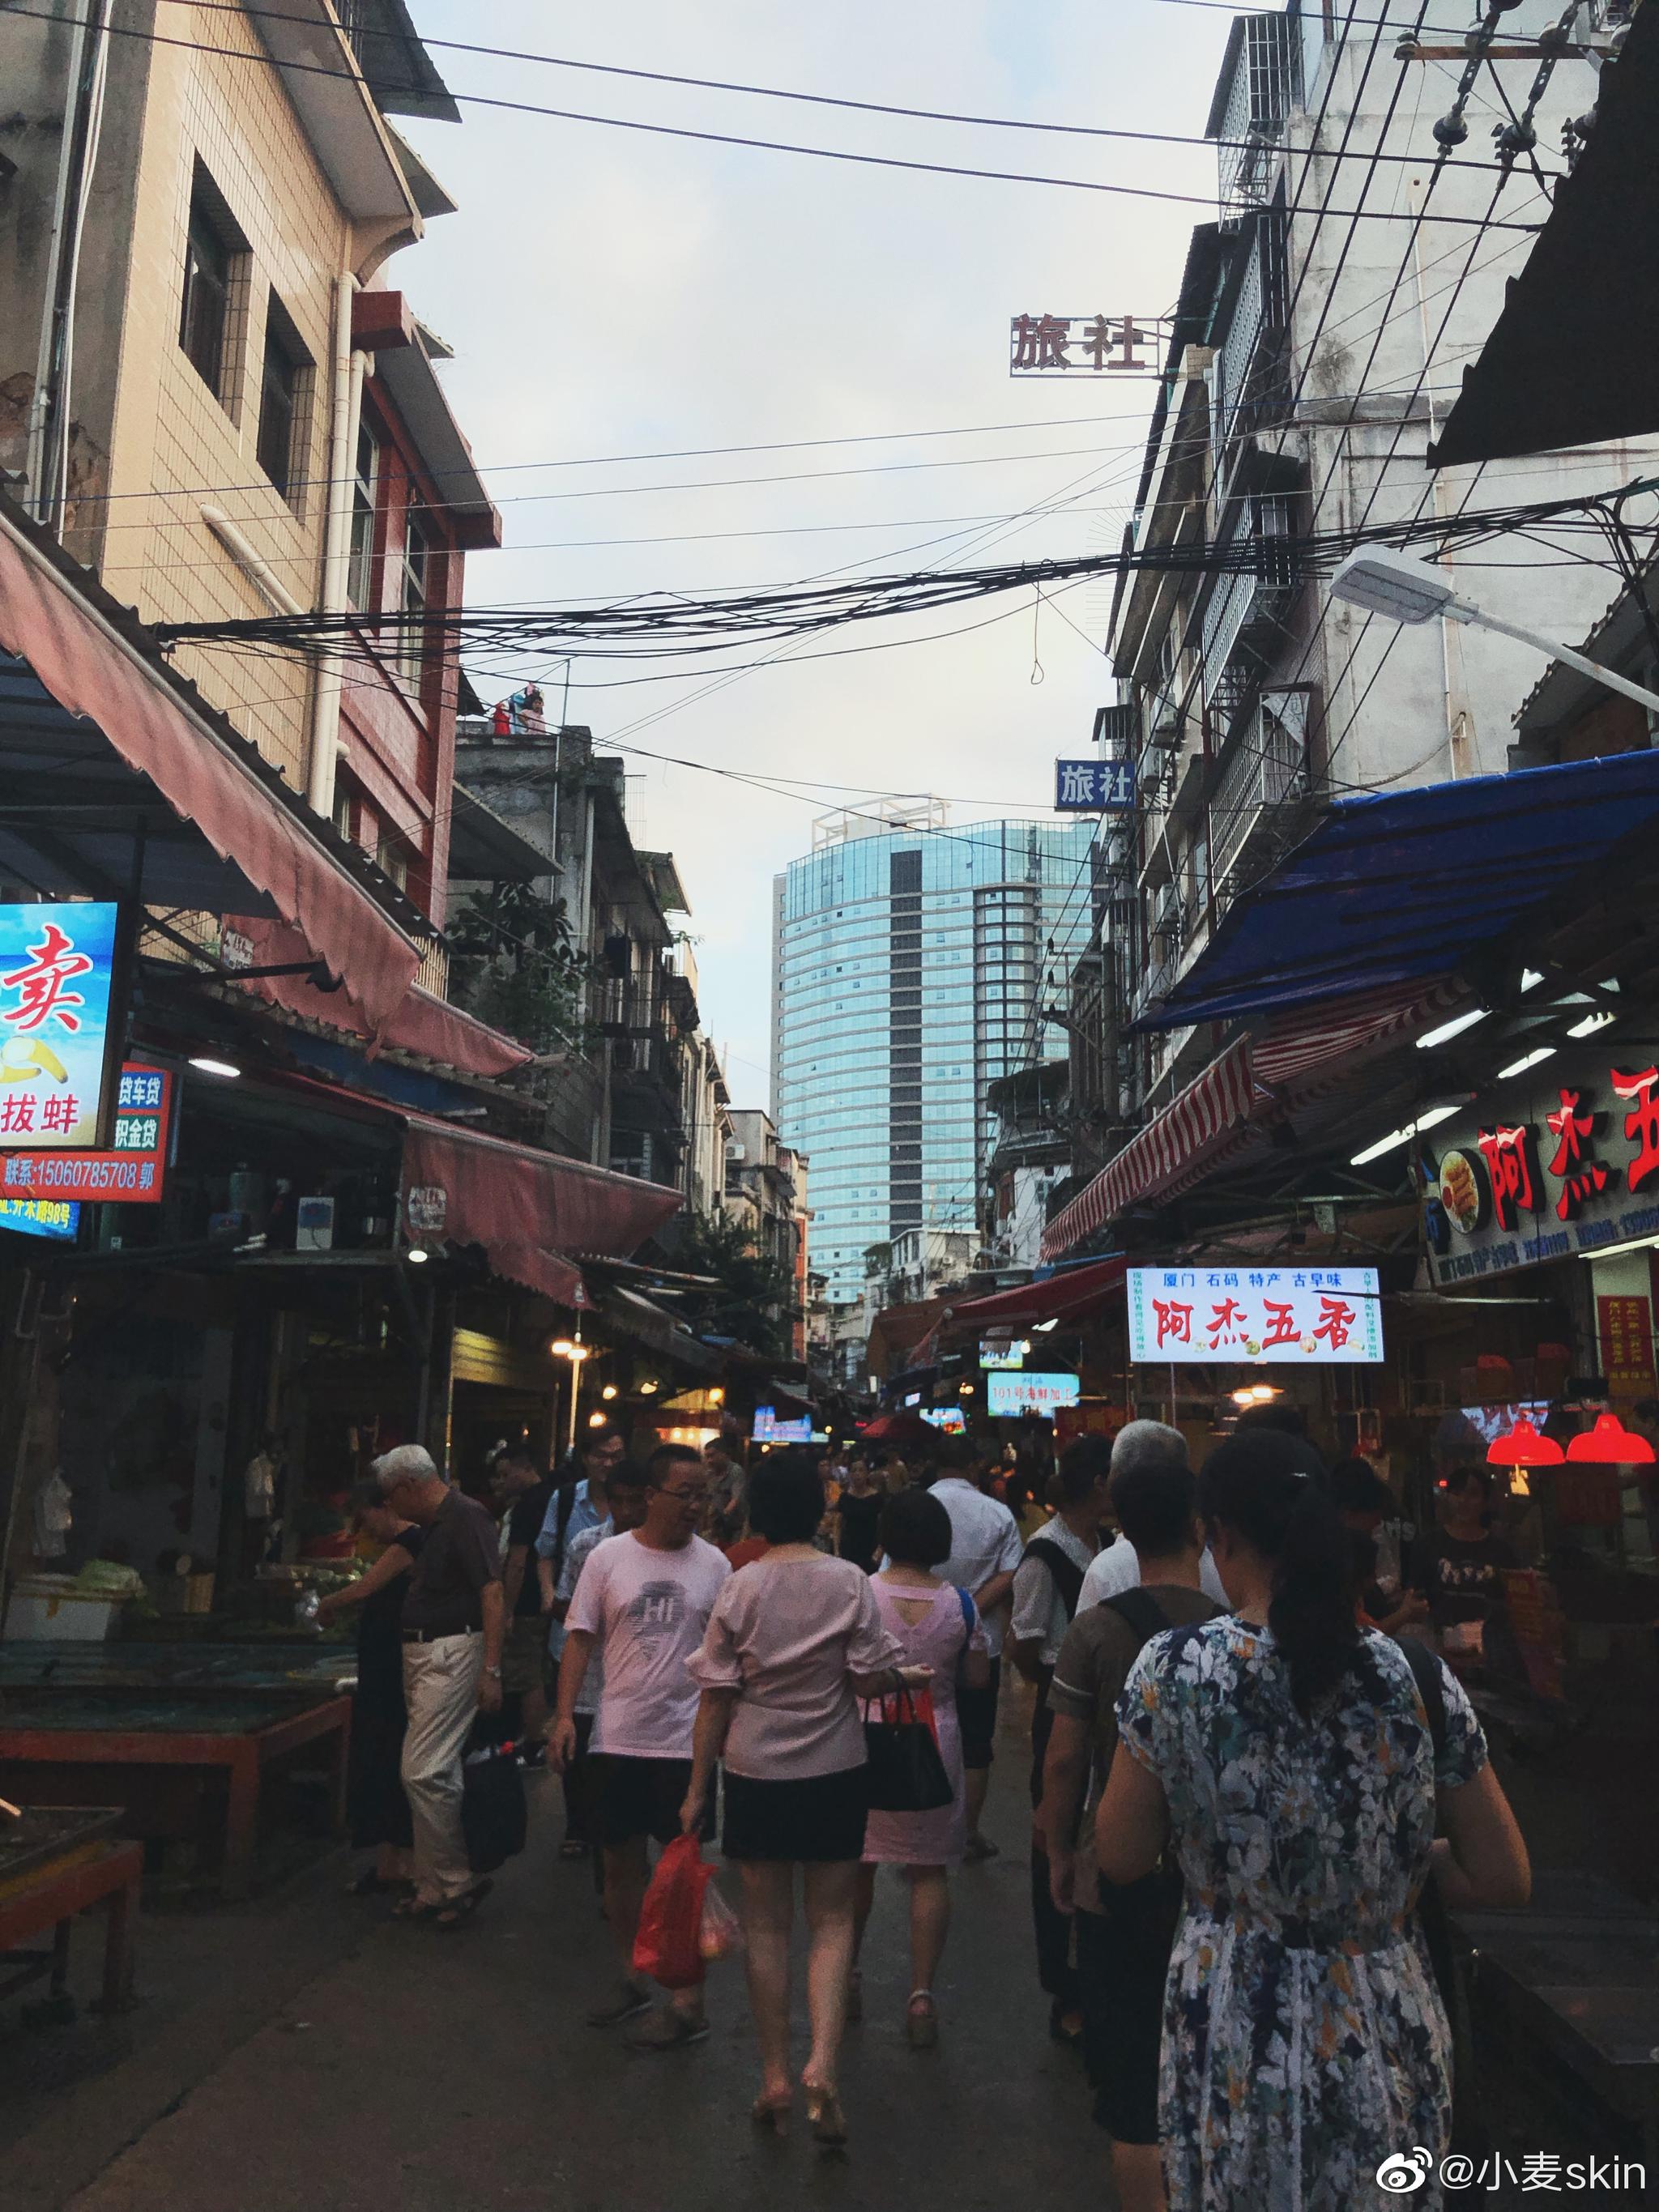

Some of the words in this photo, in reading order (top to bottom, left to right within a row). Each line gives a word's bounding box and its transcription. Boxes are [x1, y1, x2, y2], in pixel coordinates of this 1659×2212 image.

[1013, 313, 1145, 370] 旅社
[1061, 765, 1132, 803] 旅社
[2, 925, 90, 1031] 卖
[1, 1093, 79, 1134] 拔蚌
[1163, 1272, 1195, 1287] 厦门
[1206, 1273, 1239, 1287] 石码
[1249, 1272, 1281, 1287] 特产
[1292, 1272, 1342, 1287] 古早味
[1152, 1296, 1356, 1352] 阿杰五香
